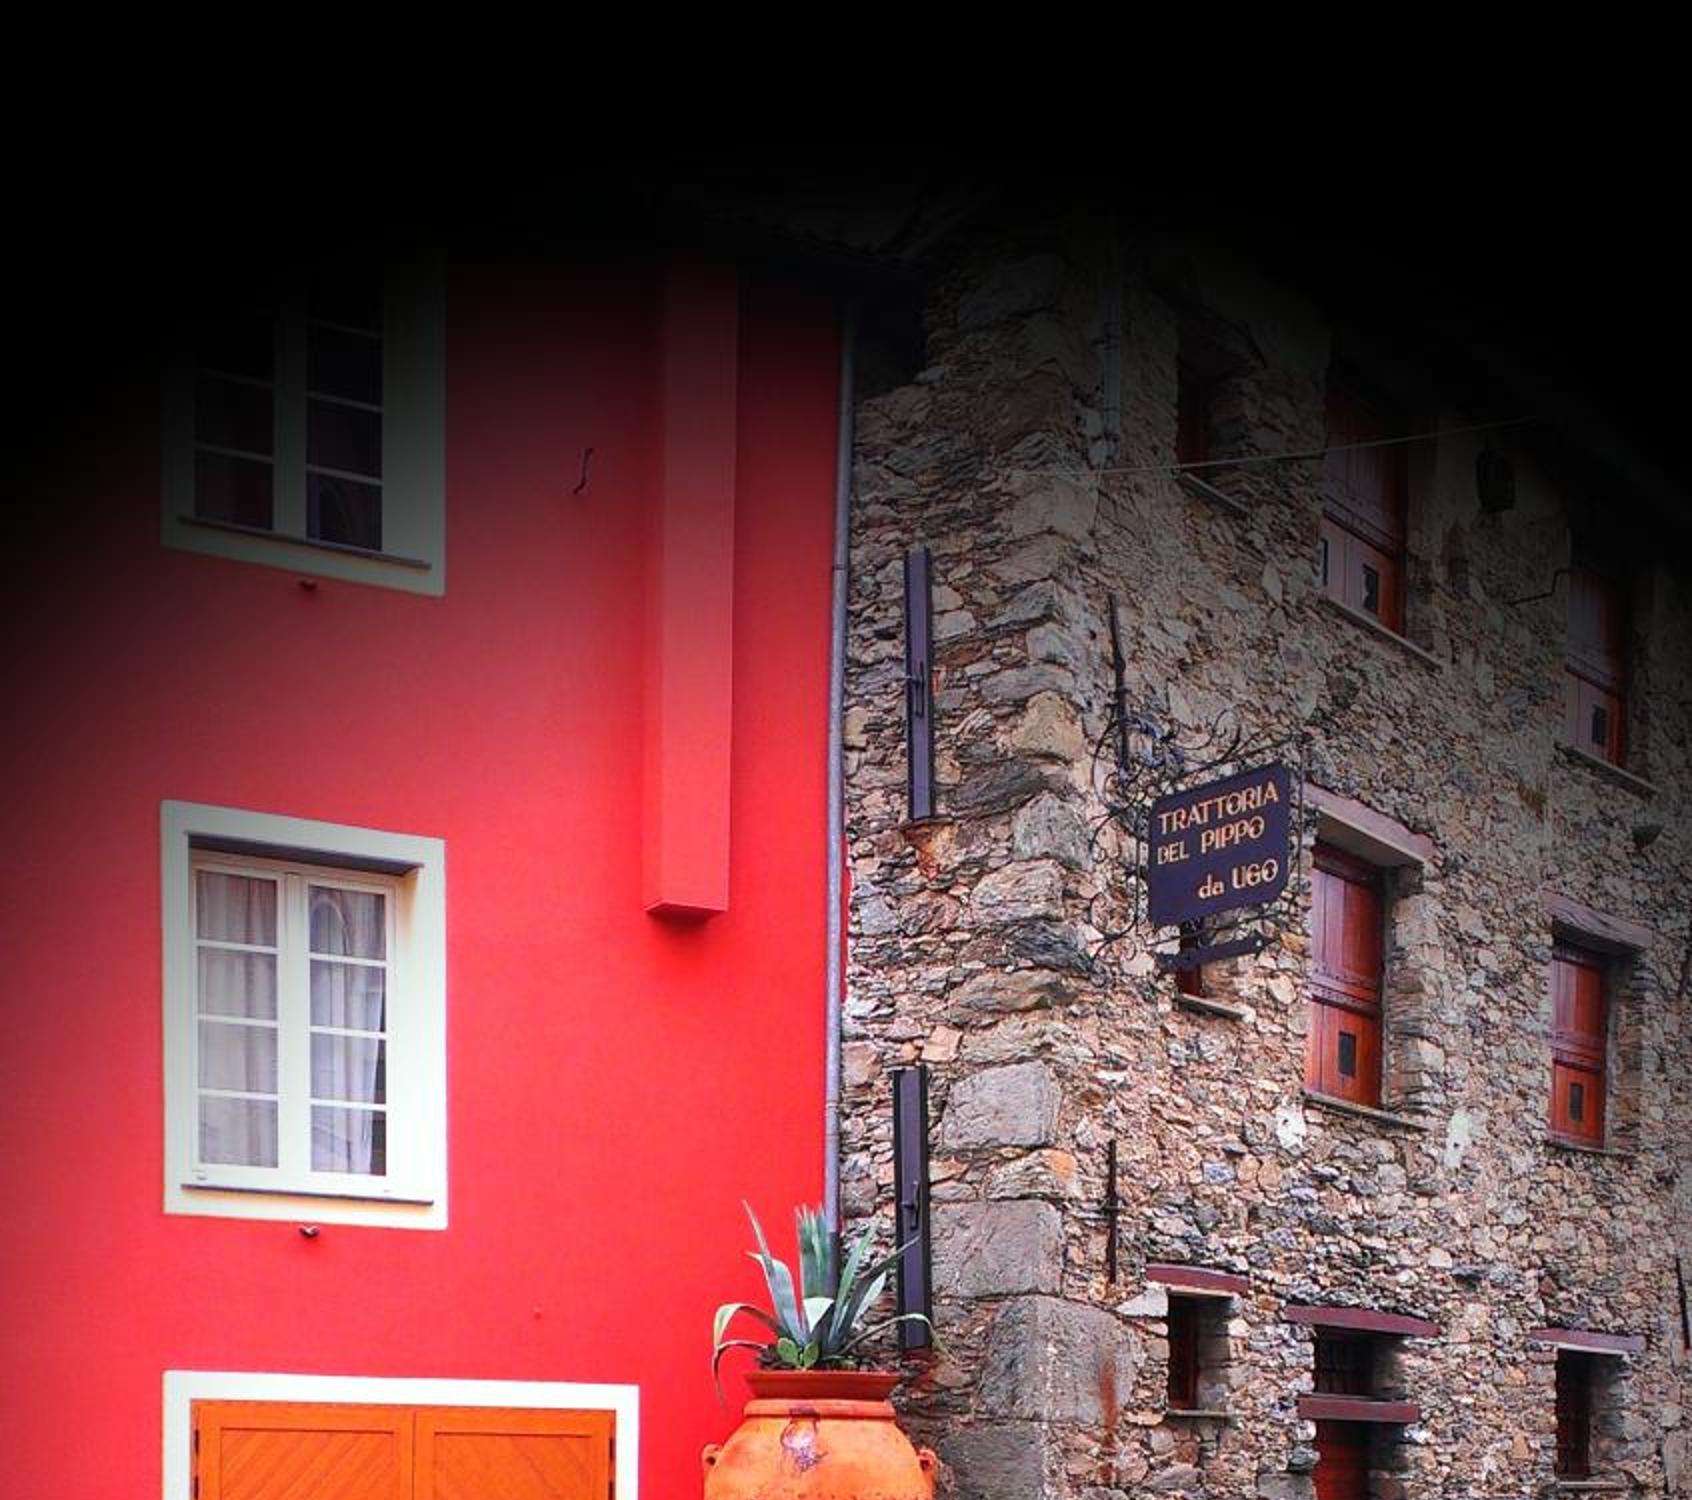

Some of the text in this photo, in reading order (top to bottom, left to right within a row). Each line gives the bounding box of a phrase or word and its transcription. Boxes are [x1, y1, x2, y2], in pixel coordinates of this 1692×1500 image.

[1158, 781, 1279, 834] TRATTORIA
[1157, 815, 1265, 865] DEL PIPPO
[1198, 859, 1279, 899] da UGO
